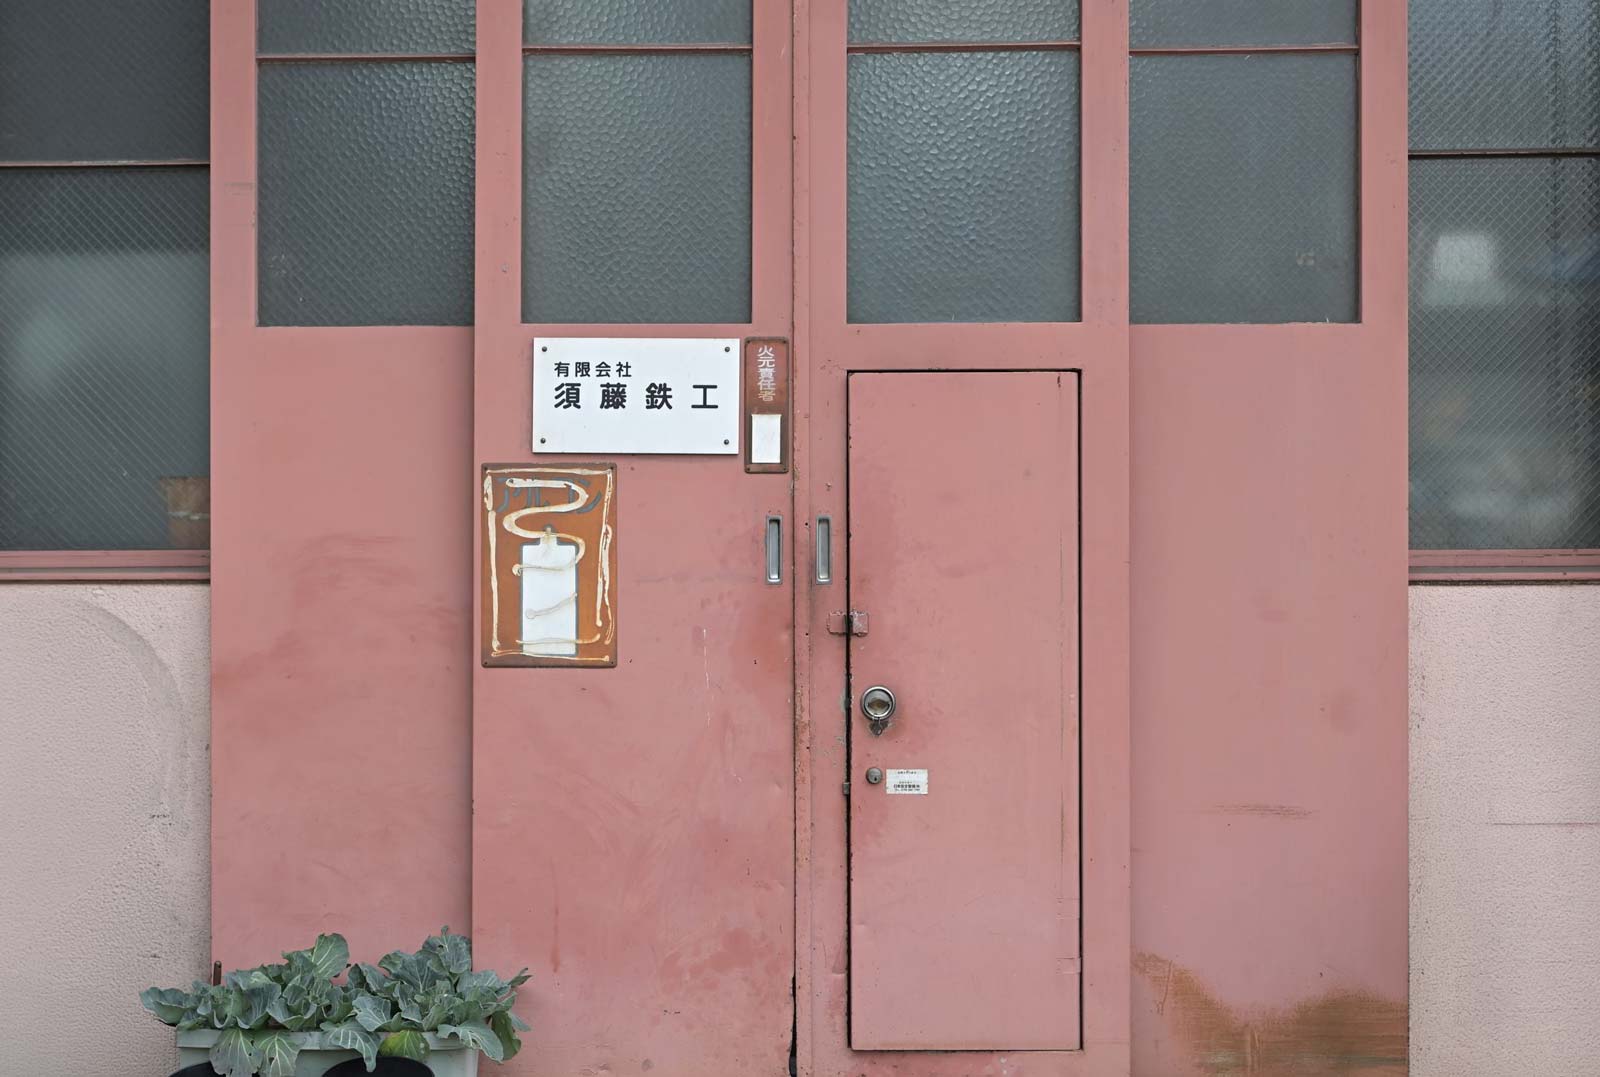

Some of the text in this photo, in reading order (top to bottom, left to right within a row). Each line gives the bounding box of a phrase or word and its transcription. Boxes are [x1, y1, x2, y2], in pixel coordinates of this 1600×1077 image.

[553, 361, 632, 378] 有限会社
[756, 344, 777, 402] 火元責任者
[553, 382, 719, 410] 須藤鉄工
